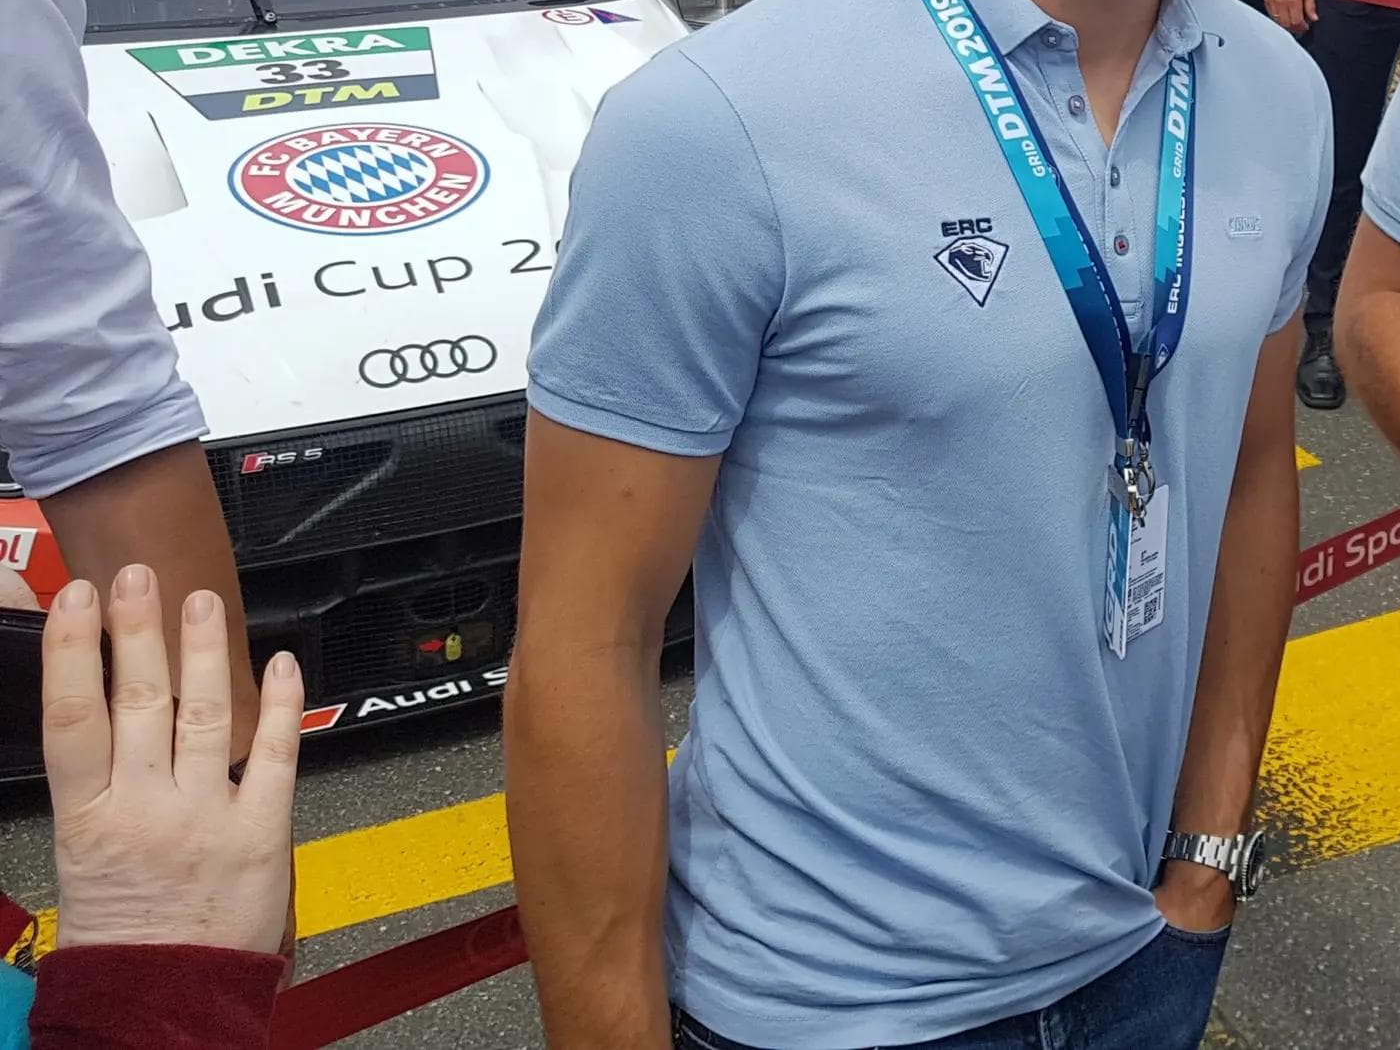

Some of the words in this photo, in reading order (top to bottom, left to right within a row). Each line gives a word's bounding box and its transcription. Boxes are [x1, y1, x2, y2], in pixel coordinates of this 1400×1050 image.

[176, 33, 407, 66] DEKRA
[255, 59, 351, 85] 33
[241, 81, 401, 112] DTM
[967, 56, 1030, 140] DTM
[1167, 53, 1193, 141] DTM
[248, 151, 291, 177] FC
[284, 127, 462, 159] BAYERN
[1021, 139, 1047, 178] GRID
[1172, 140, 1186, 180] GRID
[262, 173, 473, 228] MÜNCHEN
[941, 217, 993, 238] ERC
[313, 255, 474, 297] Cup
[501, 239, 561, 275] 2
[254, 451, 297, 470] RS
[303, 447, 323, 461] 5
[356, 679, 473, 718] Audi
